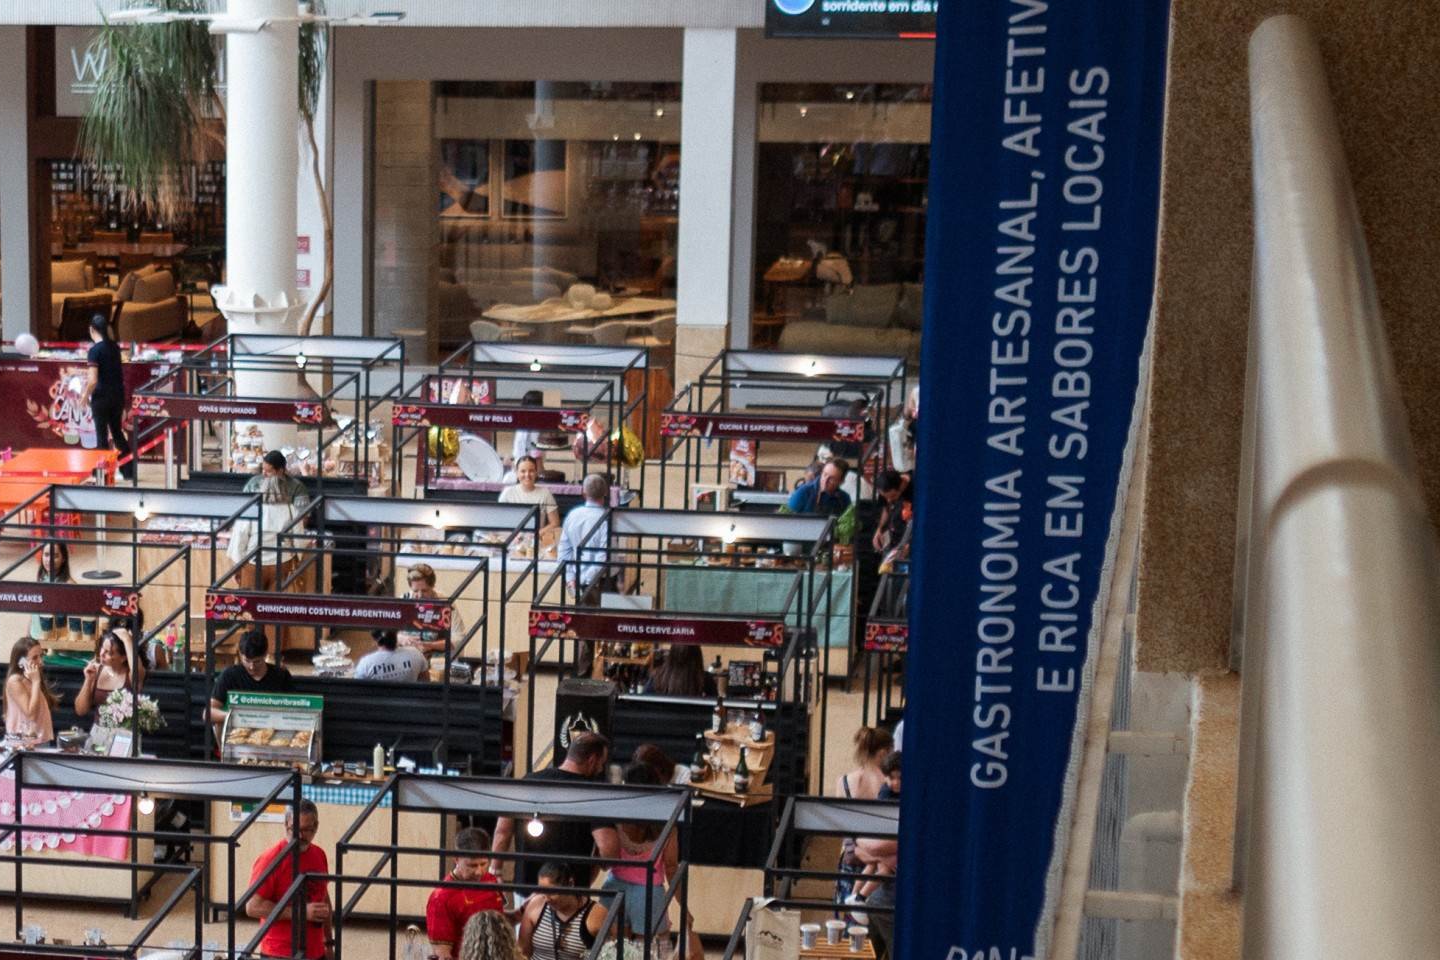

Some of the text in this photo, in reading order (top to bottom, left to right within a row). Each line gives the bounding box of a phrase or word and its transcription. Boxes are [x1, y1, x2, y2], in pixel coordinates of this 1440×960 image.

[822, 0, 887, 12] sorridente
[888, 2, 909, 12] em
[986, 171, 1046, 456] ARTESANAL,
[1036, 66, 1110, 693] E RICA EM SABORES LOCAIS
[18, 594, 43, 604] CAKES
[256, 604, 401, 619] CHIMICHURRI COSTUMES ARGENTINAS
[617, 624, 695, 636] CRULS CERVEJARIA
[970, 469, 1023, 789] GASTRONOMIA
